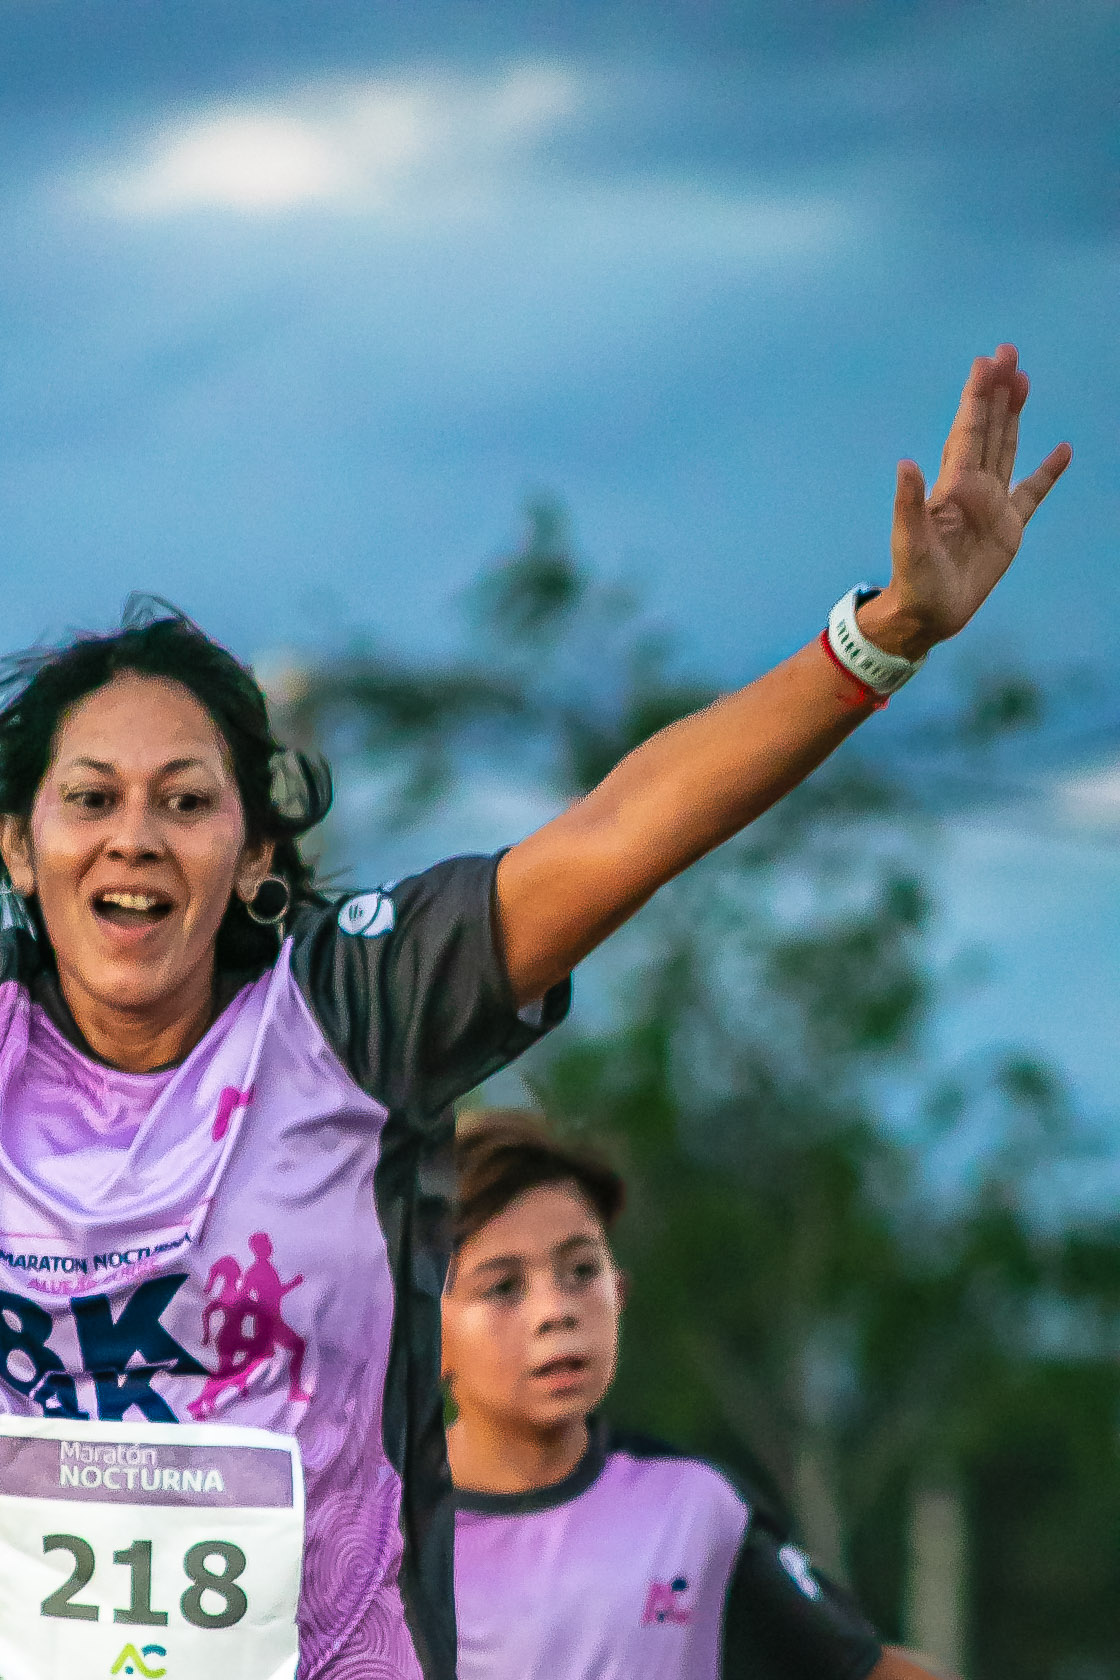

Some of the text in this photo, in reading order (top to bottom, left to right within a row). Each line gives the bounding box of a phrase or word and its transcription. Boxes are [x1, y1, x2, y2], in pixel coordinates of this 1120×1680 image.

[60, 1440, 157, 1466] Maratón
[60, 1465, 224, 1492] NOCTURNA
[40, 1534, 248, 1629] 218
